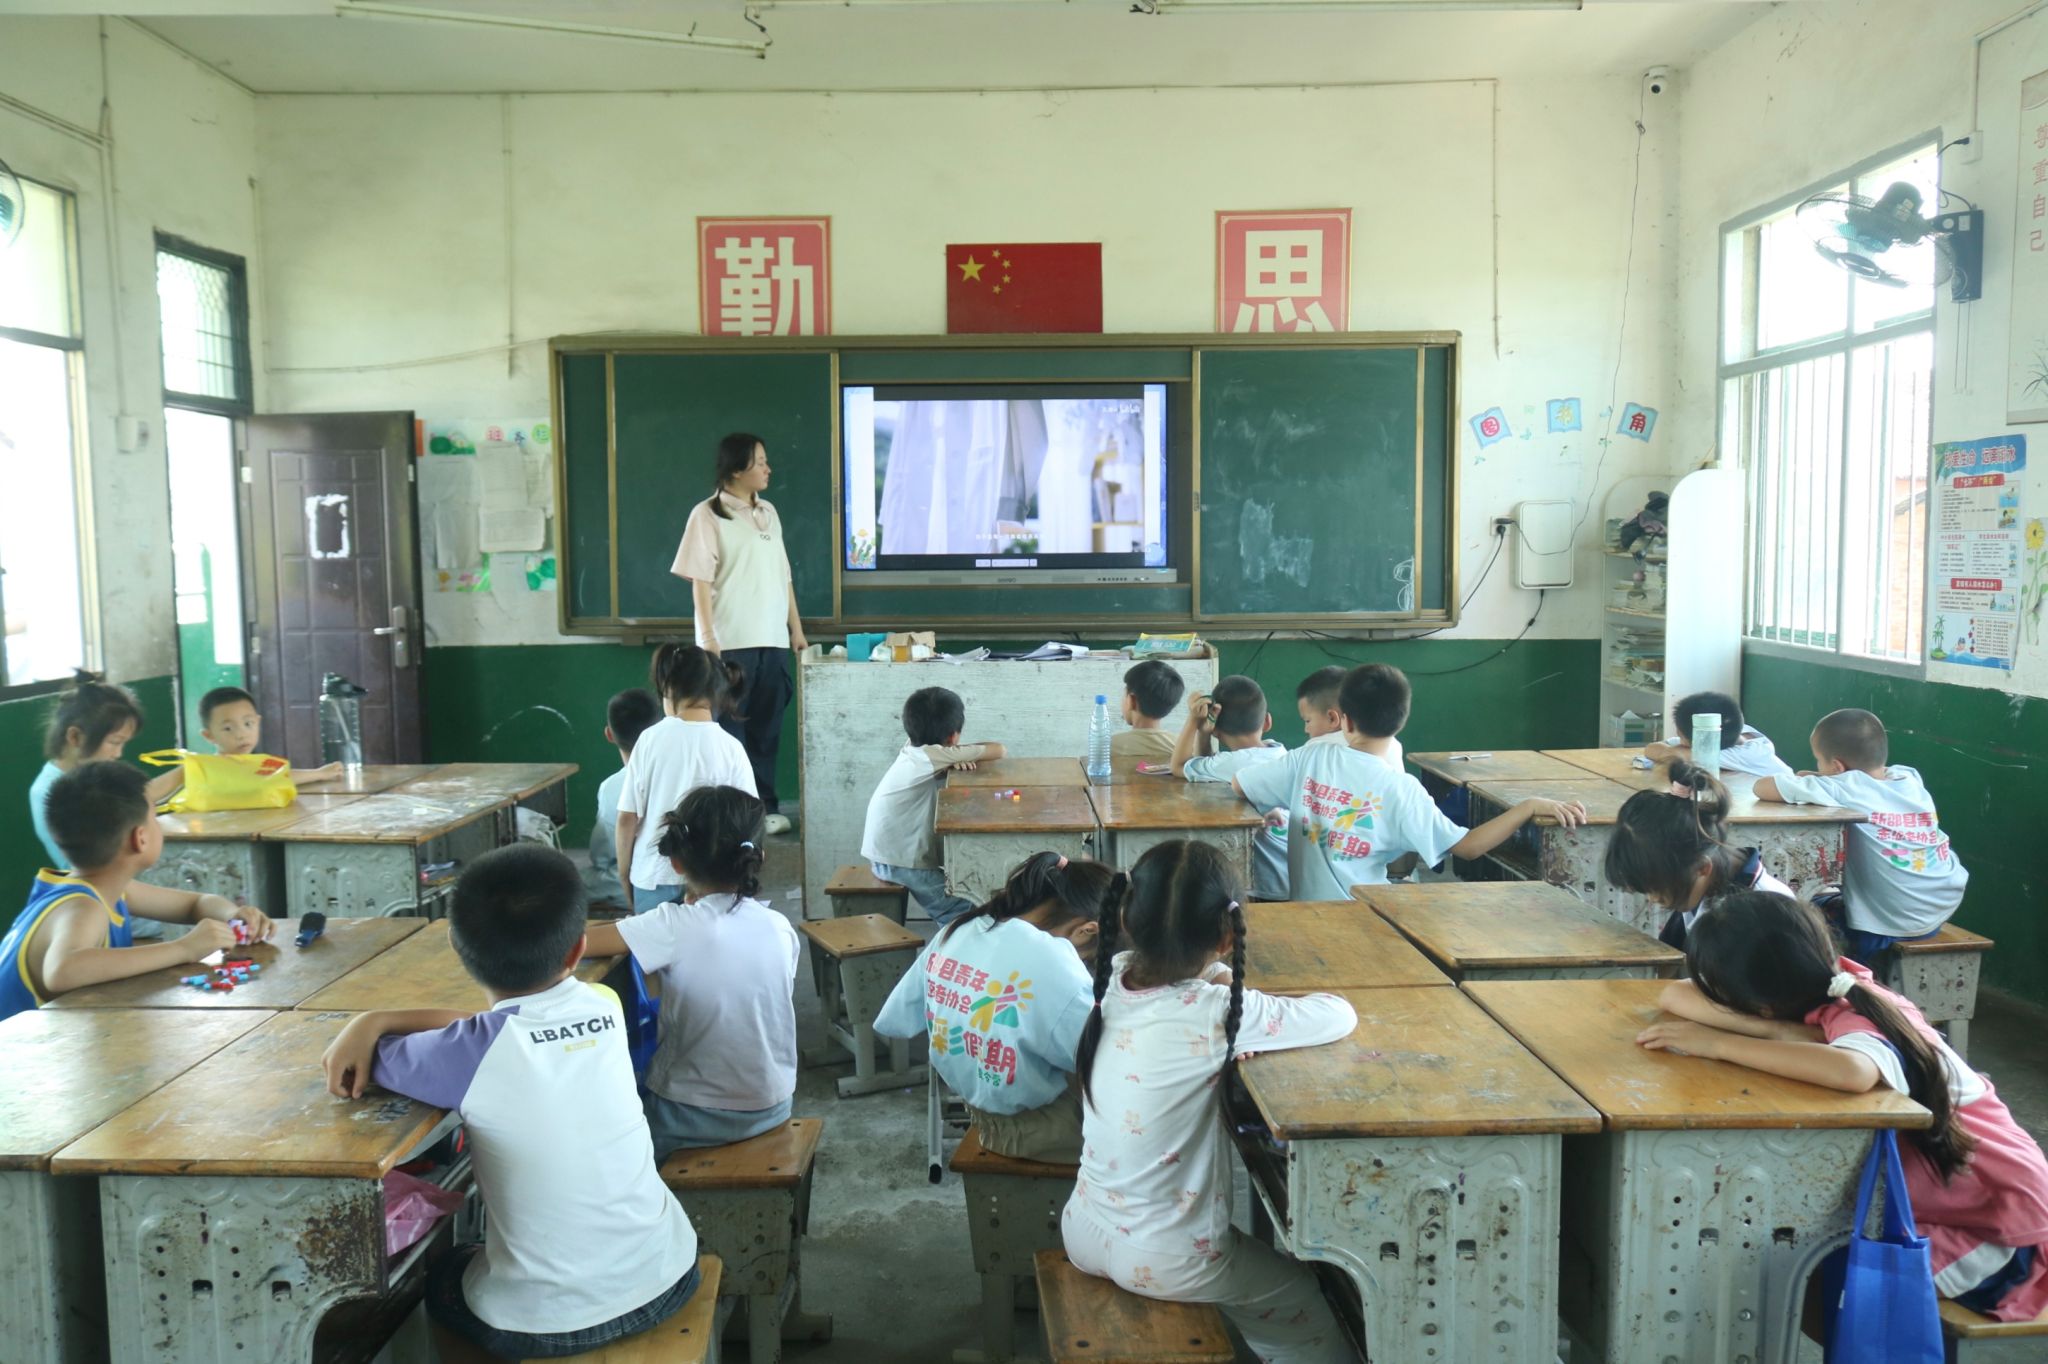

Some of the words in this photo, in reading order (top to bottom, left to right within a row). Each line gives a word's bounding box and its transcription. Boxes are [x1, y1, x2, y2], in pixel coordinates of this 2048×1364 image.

[715, 237, 814, 334] 勤
[1233, 230, 1334, 332] 思
[1481, 416, 1500, 437] 图
[1629, 412, 1647, 433] 角
